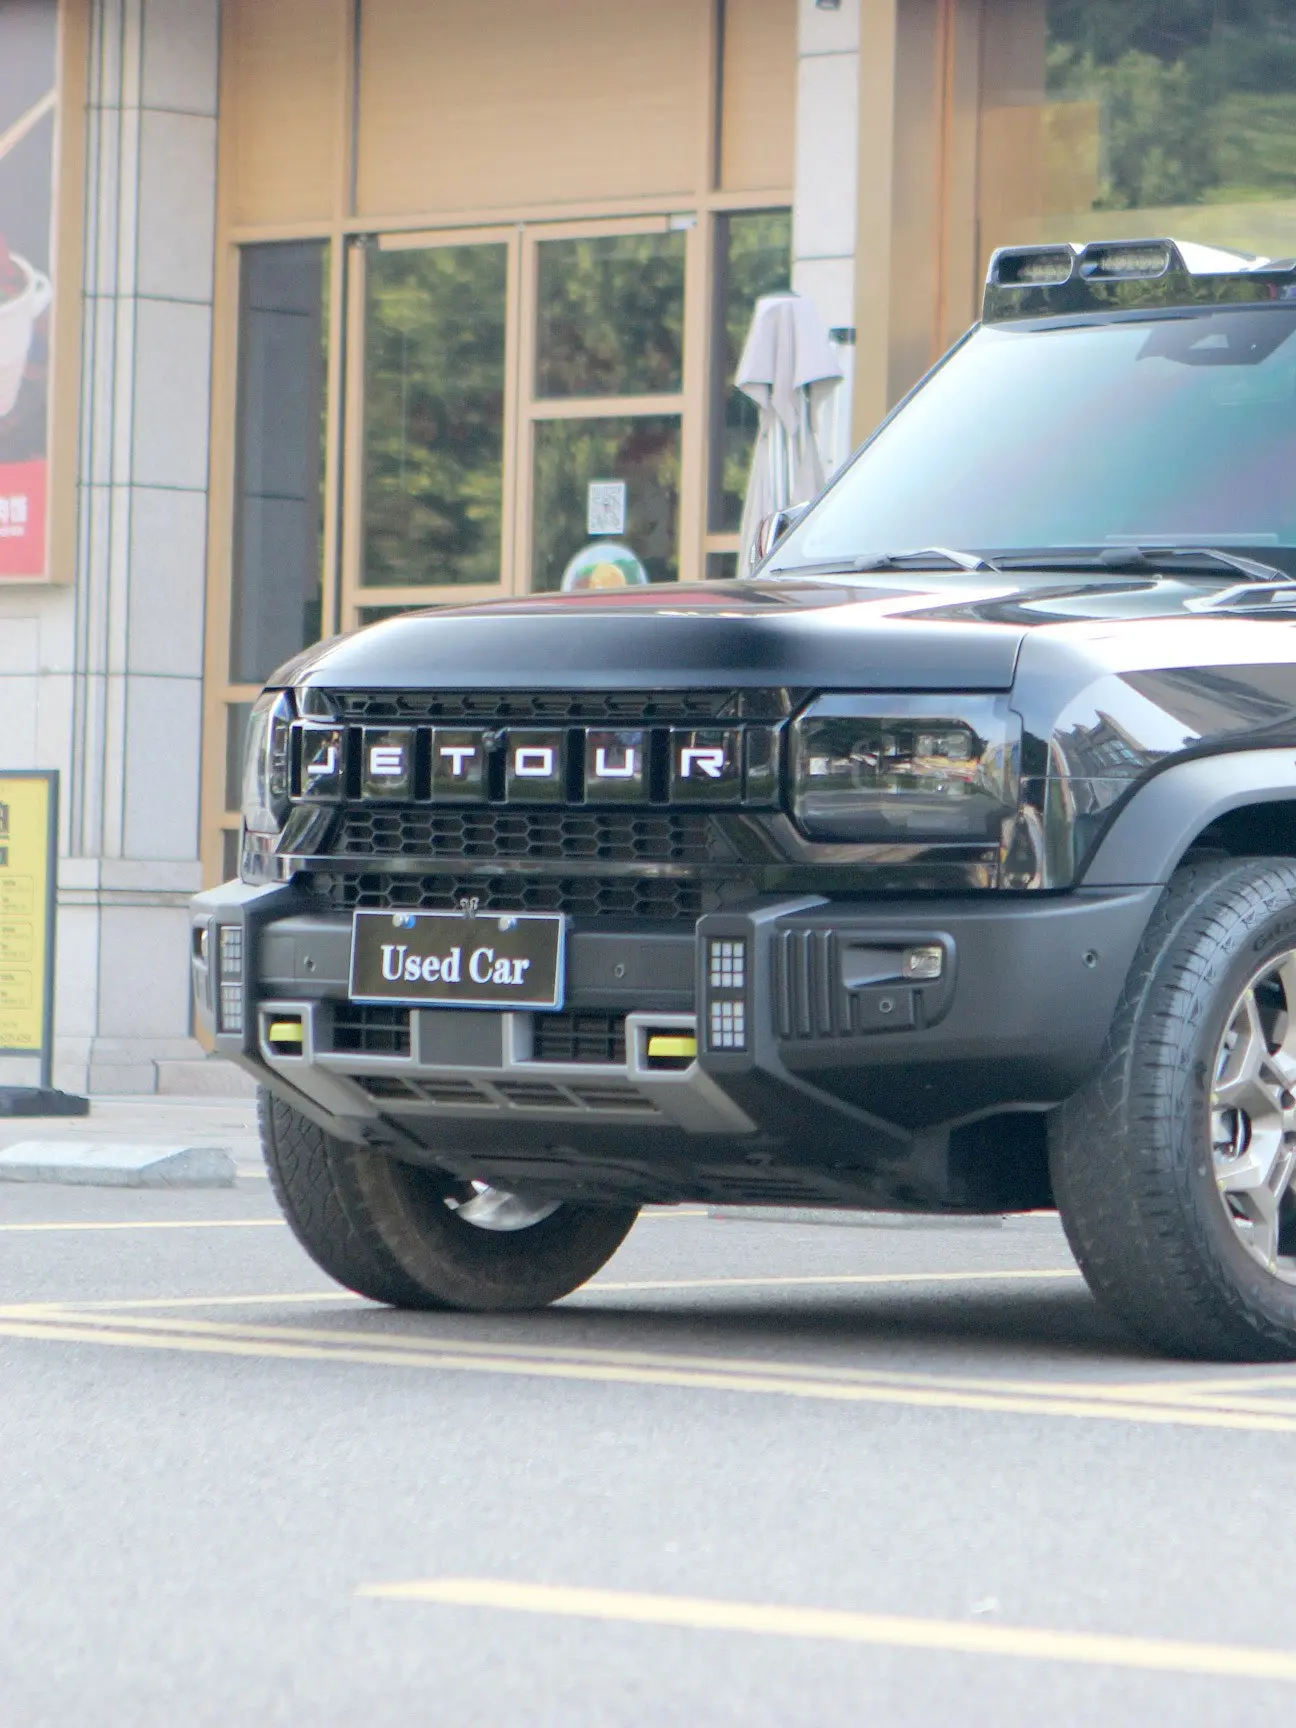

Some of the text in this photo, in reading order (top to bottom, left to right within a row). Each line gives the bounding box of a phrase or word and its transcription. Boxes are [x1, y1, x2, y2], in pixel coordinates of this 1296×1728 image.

[306, 746, 727, 779] JETOUR
[380, 944, 531, 985] Used Car
